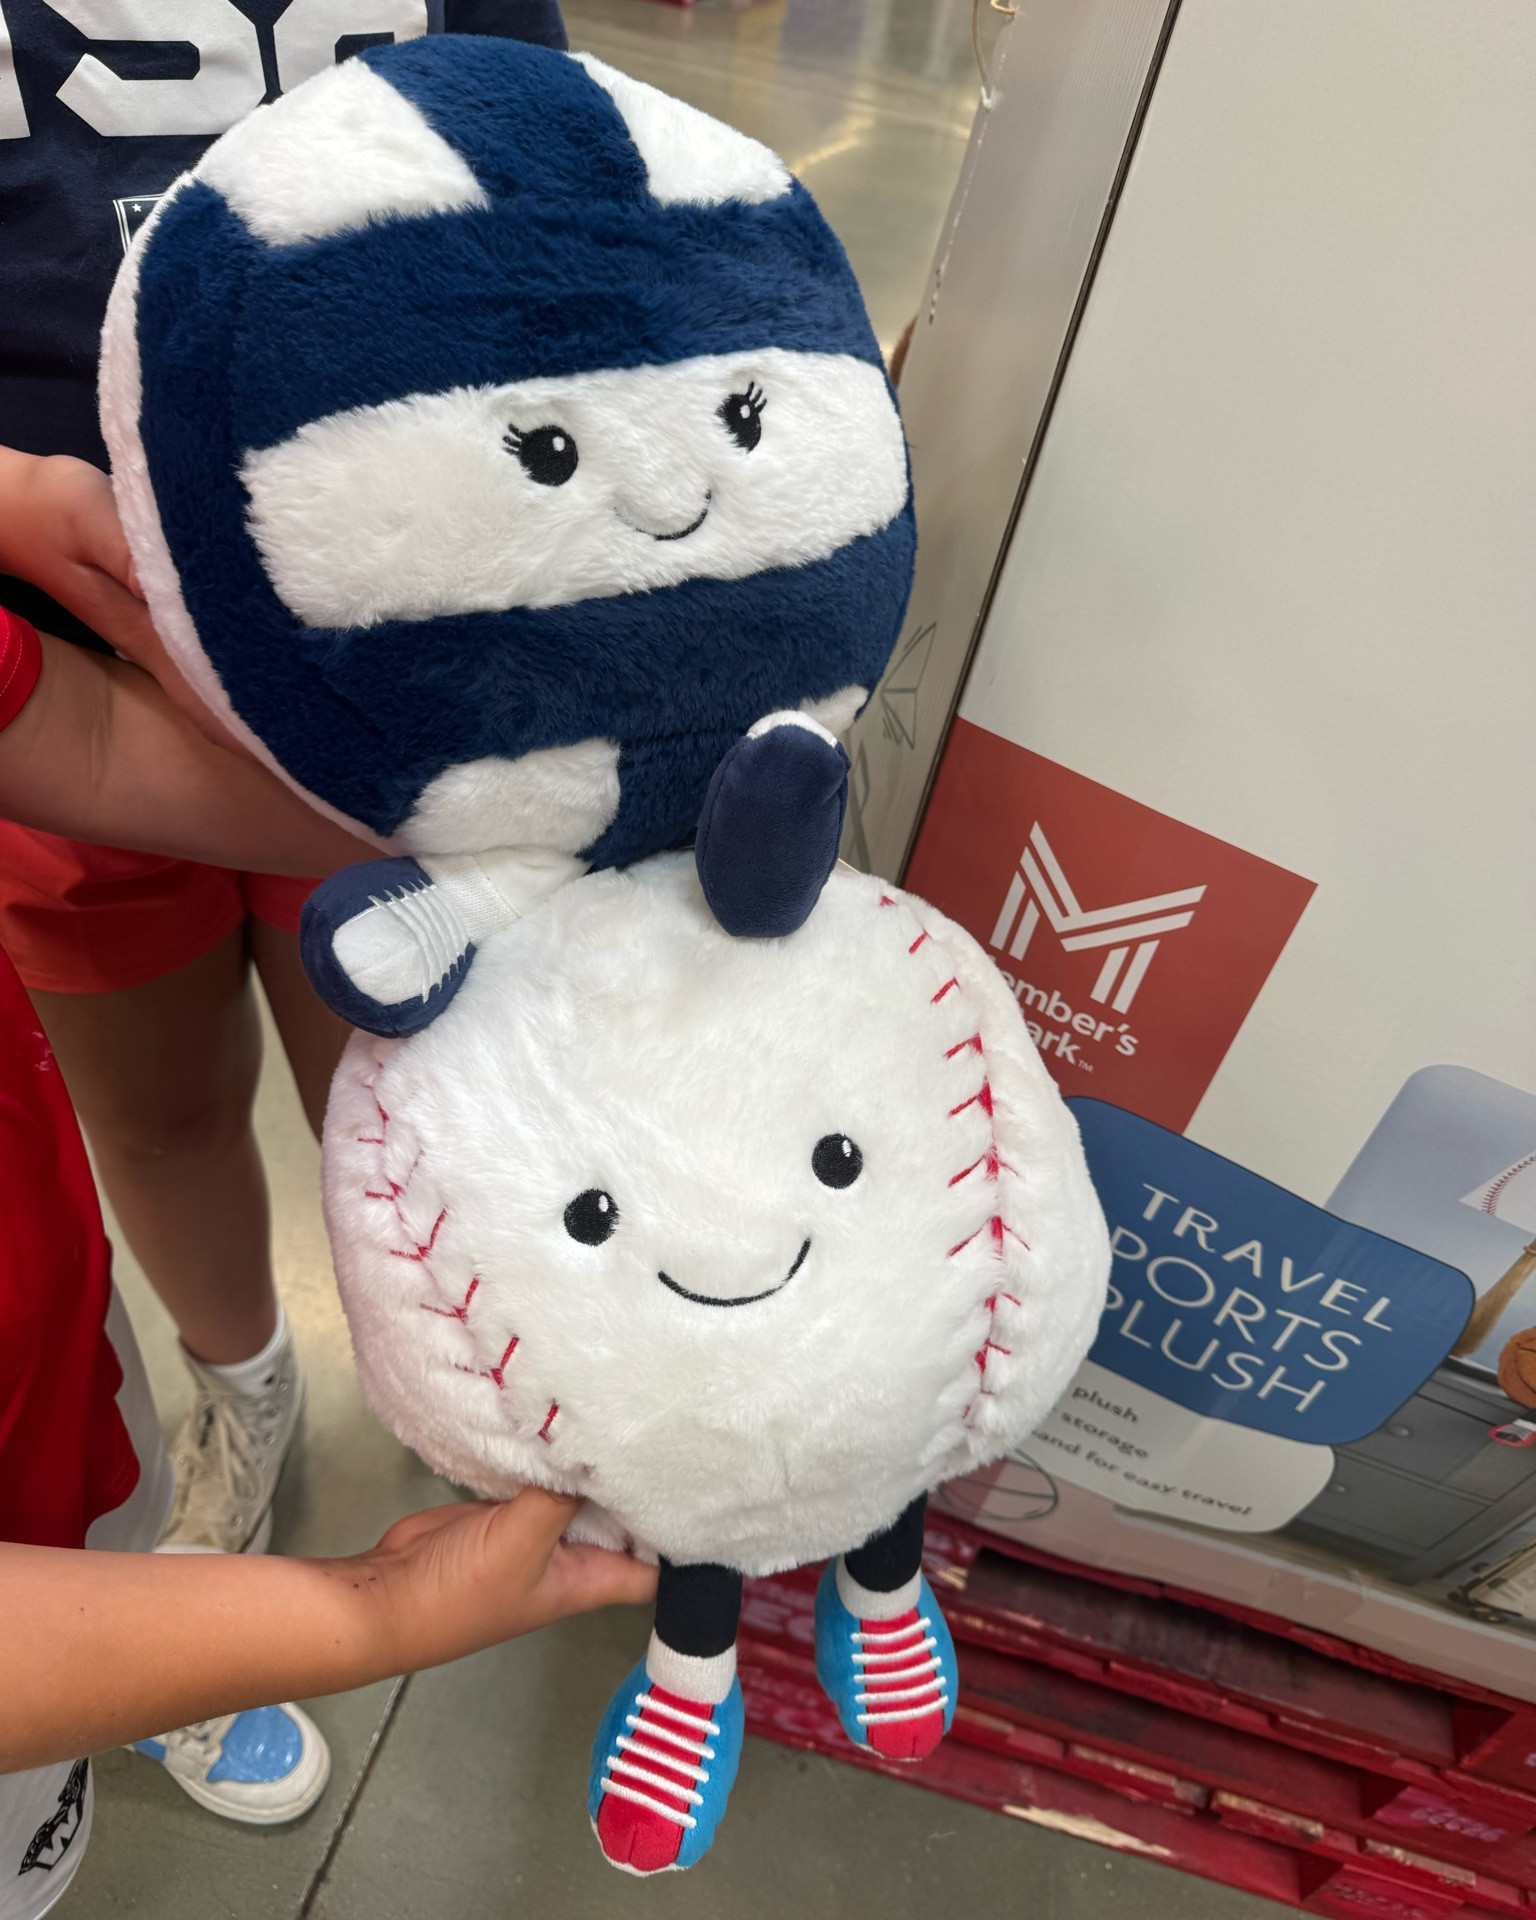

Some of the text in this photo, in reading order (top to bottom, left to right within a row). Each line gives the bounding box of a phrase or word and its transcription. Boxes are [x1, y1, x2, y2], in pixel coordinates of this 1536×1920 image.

[988, 955, 1140, 1057] ember's
[1021, 1008, 1081, 1066] ark
[1111, 1225, 1363, 1371] PORTS
[1142, 1182, 1393, 1332] TRAVEL
[1061, 1411, 1149, 1459] storage
[1071, 1386, 1138, 1423] plush
[1031, 1428, 1253, 1516] and for easy travel
